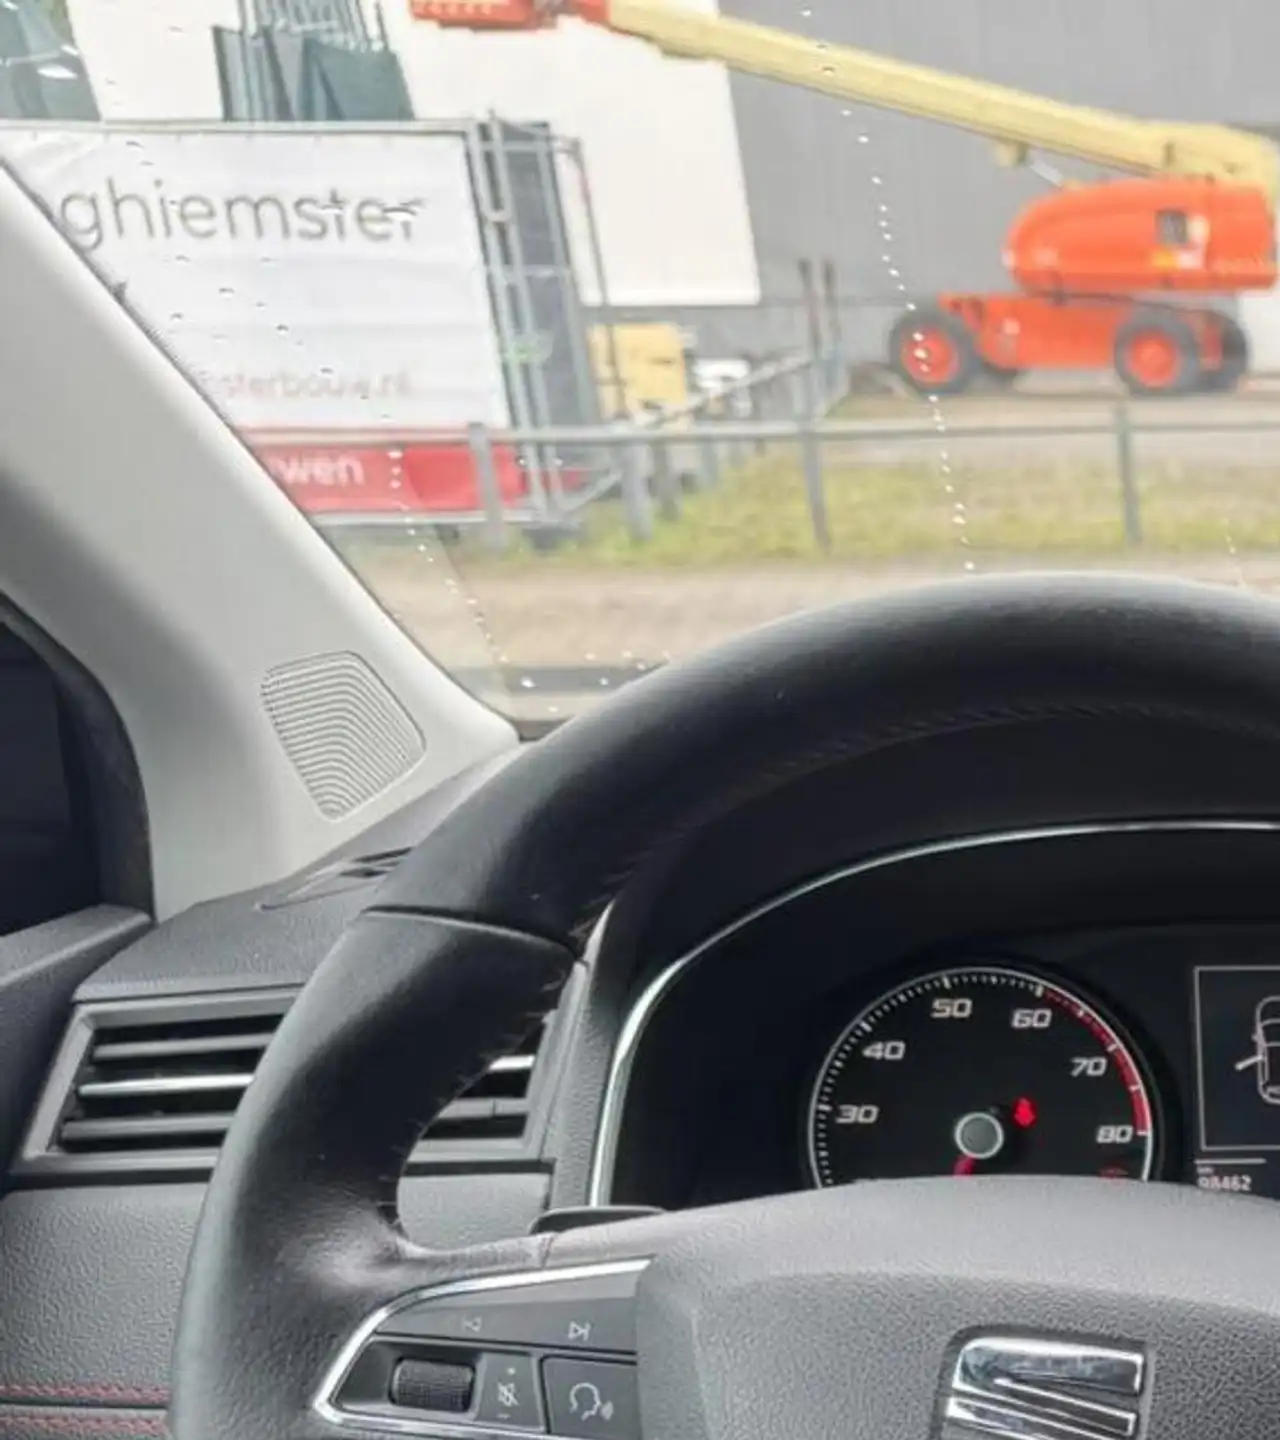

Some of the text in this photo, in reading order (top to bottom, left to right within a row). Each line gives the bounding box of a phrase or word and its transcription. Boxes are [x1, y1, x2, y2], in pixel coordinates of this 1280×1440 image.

[932, 999, 972, 1017] 50
[1012, 1009, 1051, 1028] 60
[863, 1042, 905, 1059] 40
[1072, 1057, 1107, 1076] 70
[837, 1105, 878, 1123] 30
[1097, 1126, 1133, 1143] 80
